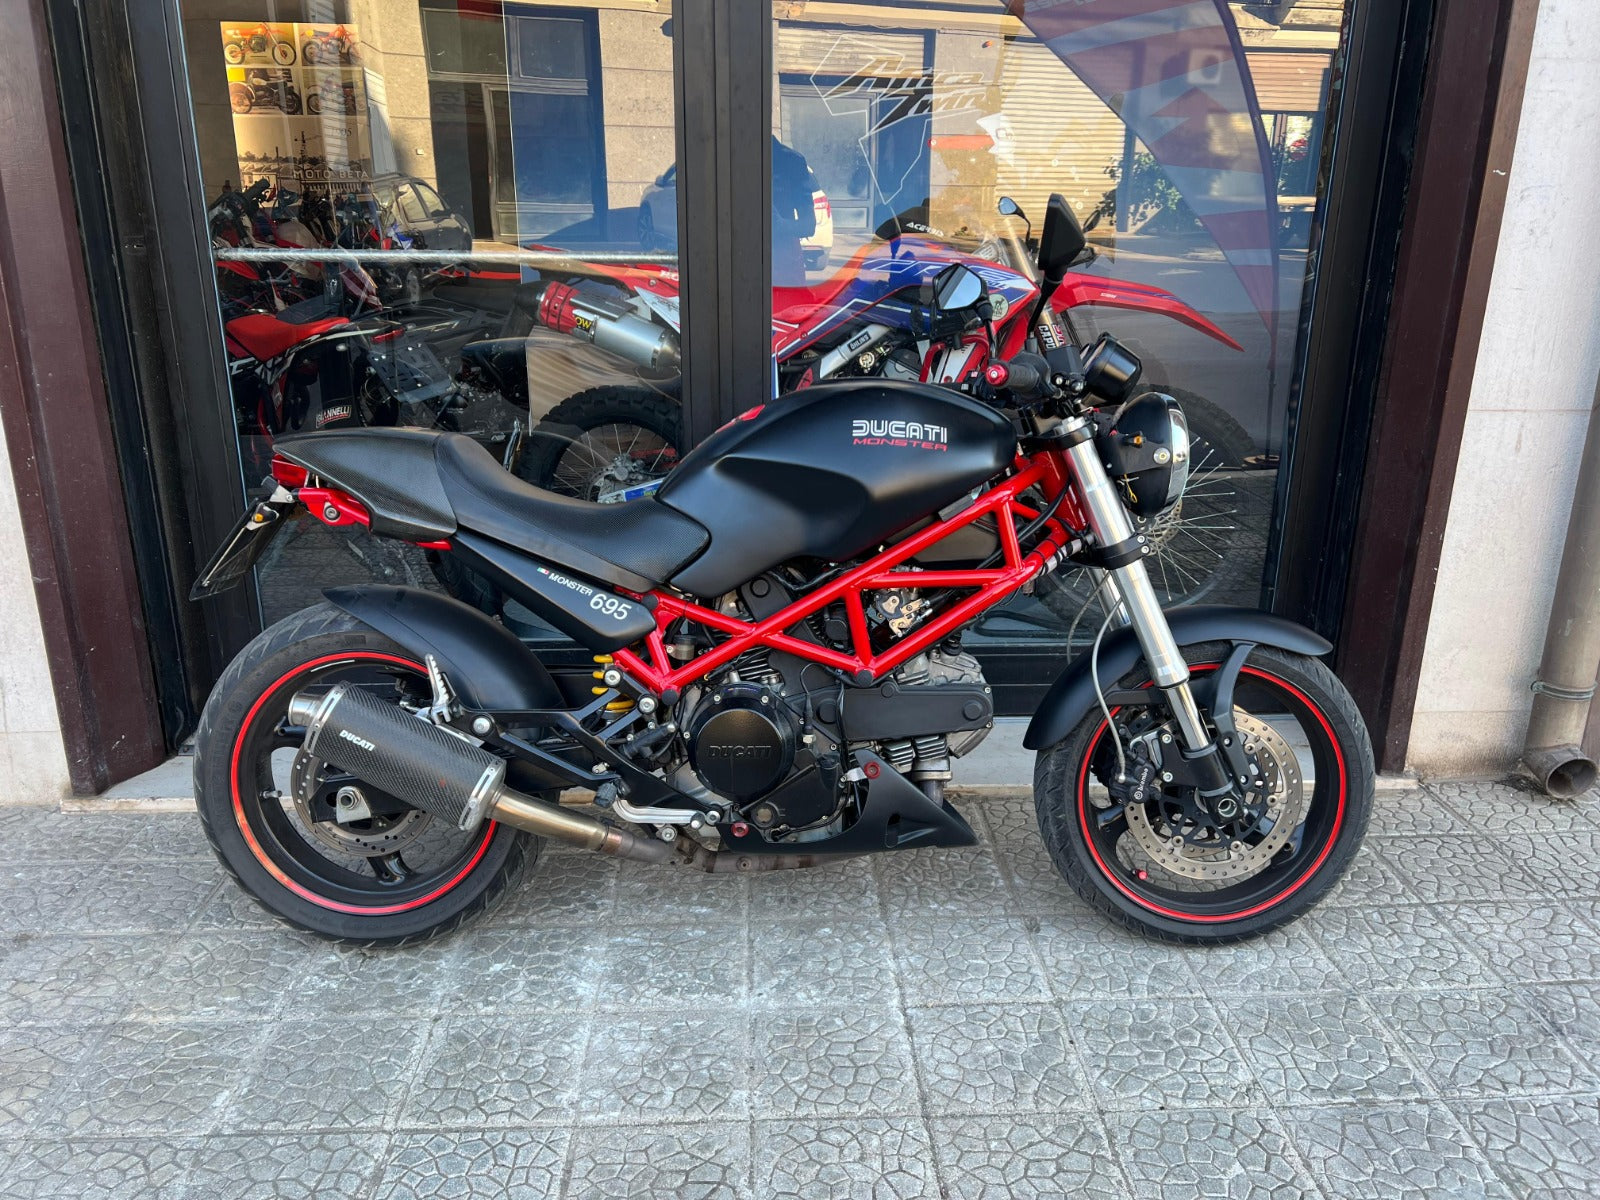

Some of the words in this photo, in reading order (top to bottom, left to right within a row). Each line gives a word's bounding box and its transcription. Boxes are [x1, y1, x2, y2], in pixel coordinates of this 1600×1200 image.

[293, 169, 331, 179] MOTO
[339, 170, 369, 179] BETA
[852, 420, 948, 443] DUCATI
[853, 438, 948, 452] MONSTER
[548, 572, 593, 596] MONSTER
[590, 593, 632, 620] 695
[339, 729, 376, 751] DUCATI
[708, 745, 772, 759] DUCATI
